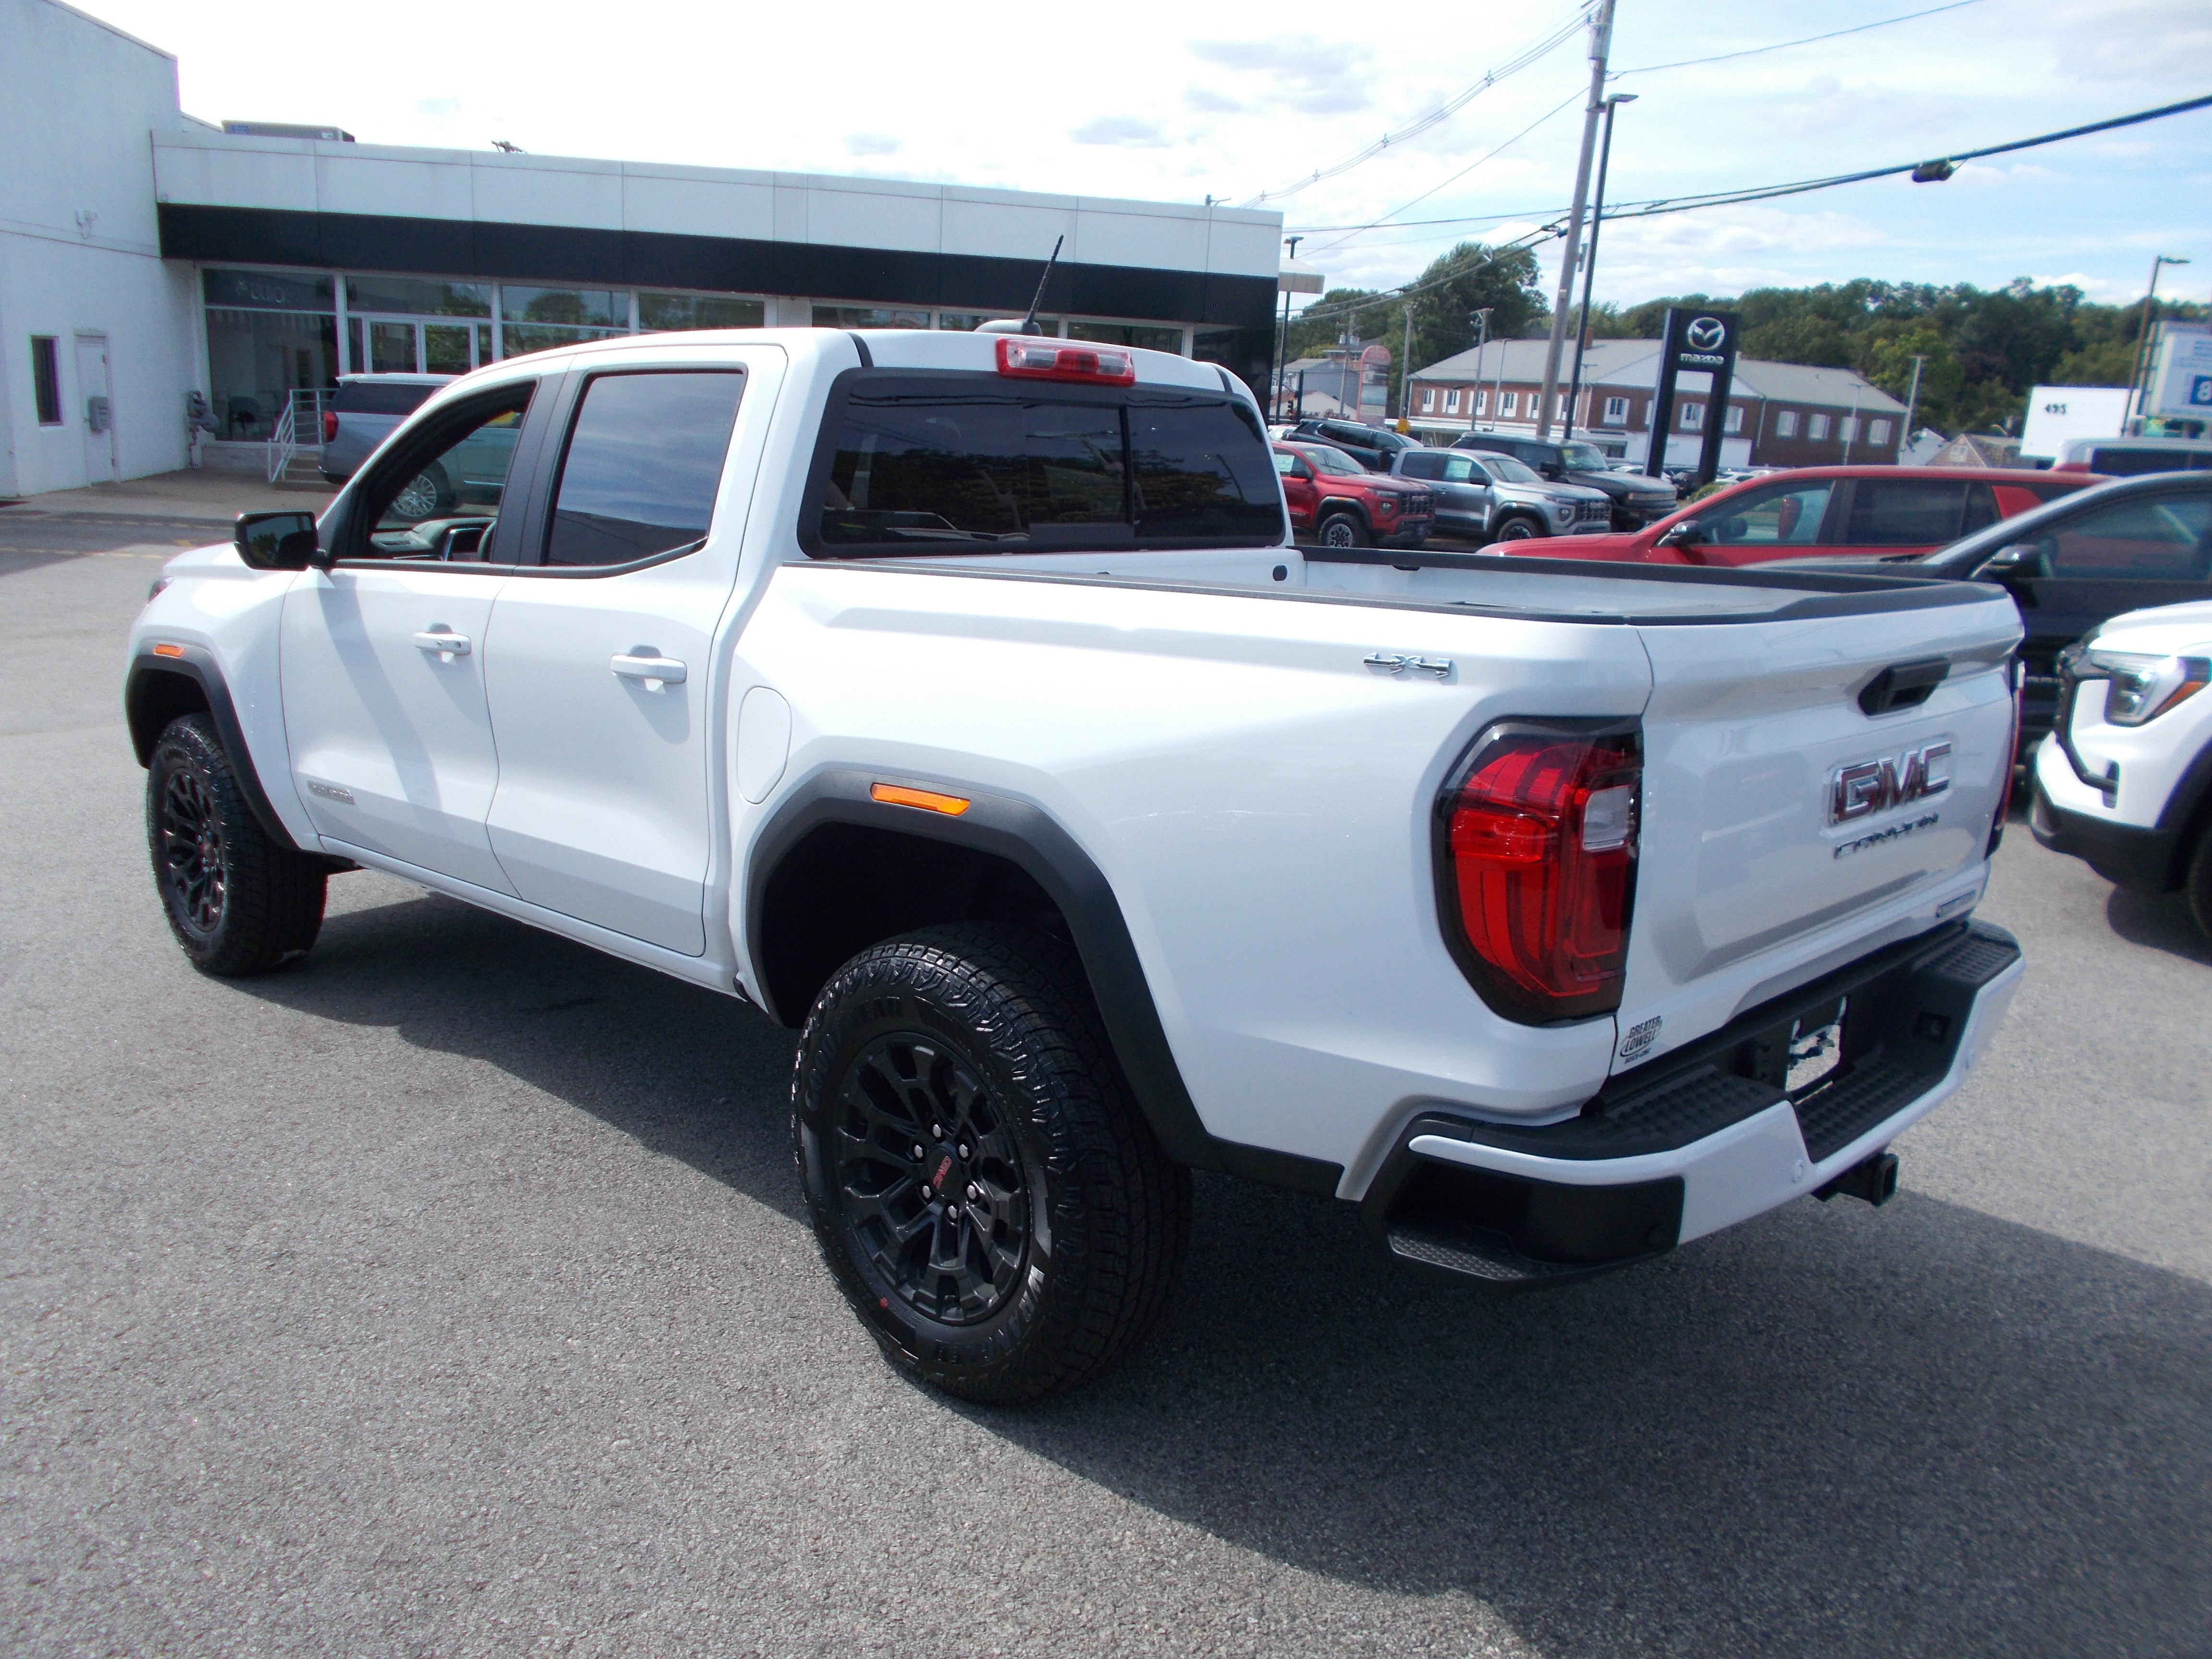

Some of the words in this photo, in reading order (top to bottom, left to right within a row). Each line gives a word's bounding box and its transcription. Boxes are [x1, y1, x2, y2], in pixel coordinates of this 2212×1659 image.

[1680, 353, 1724, 365] mazda
[2044, 403, 2067, 416] 495
[1831, 741, 1952, 823] GMC
[1629, 1015, 1661, 1038] GREATER
[1624, 1029, 1656, 1052] LOWELL
[933, 1155, 952, 1190] GMC
